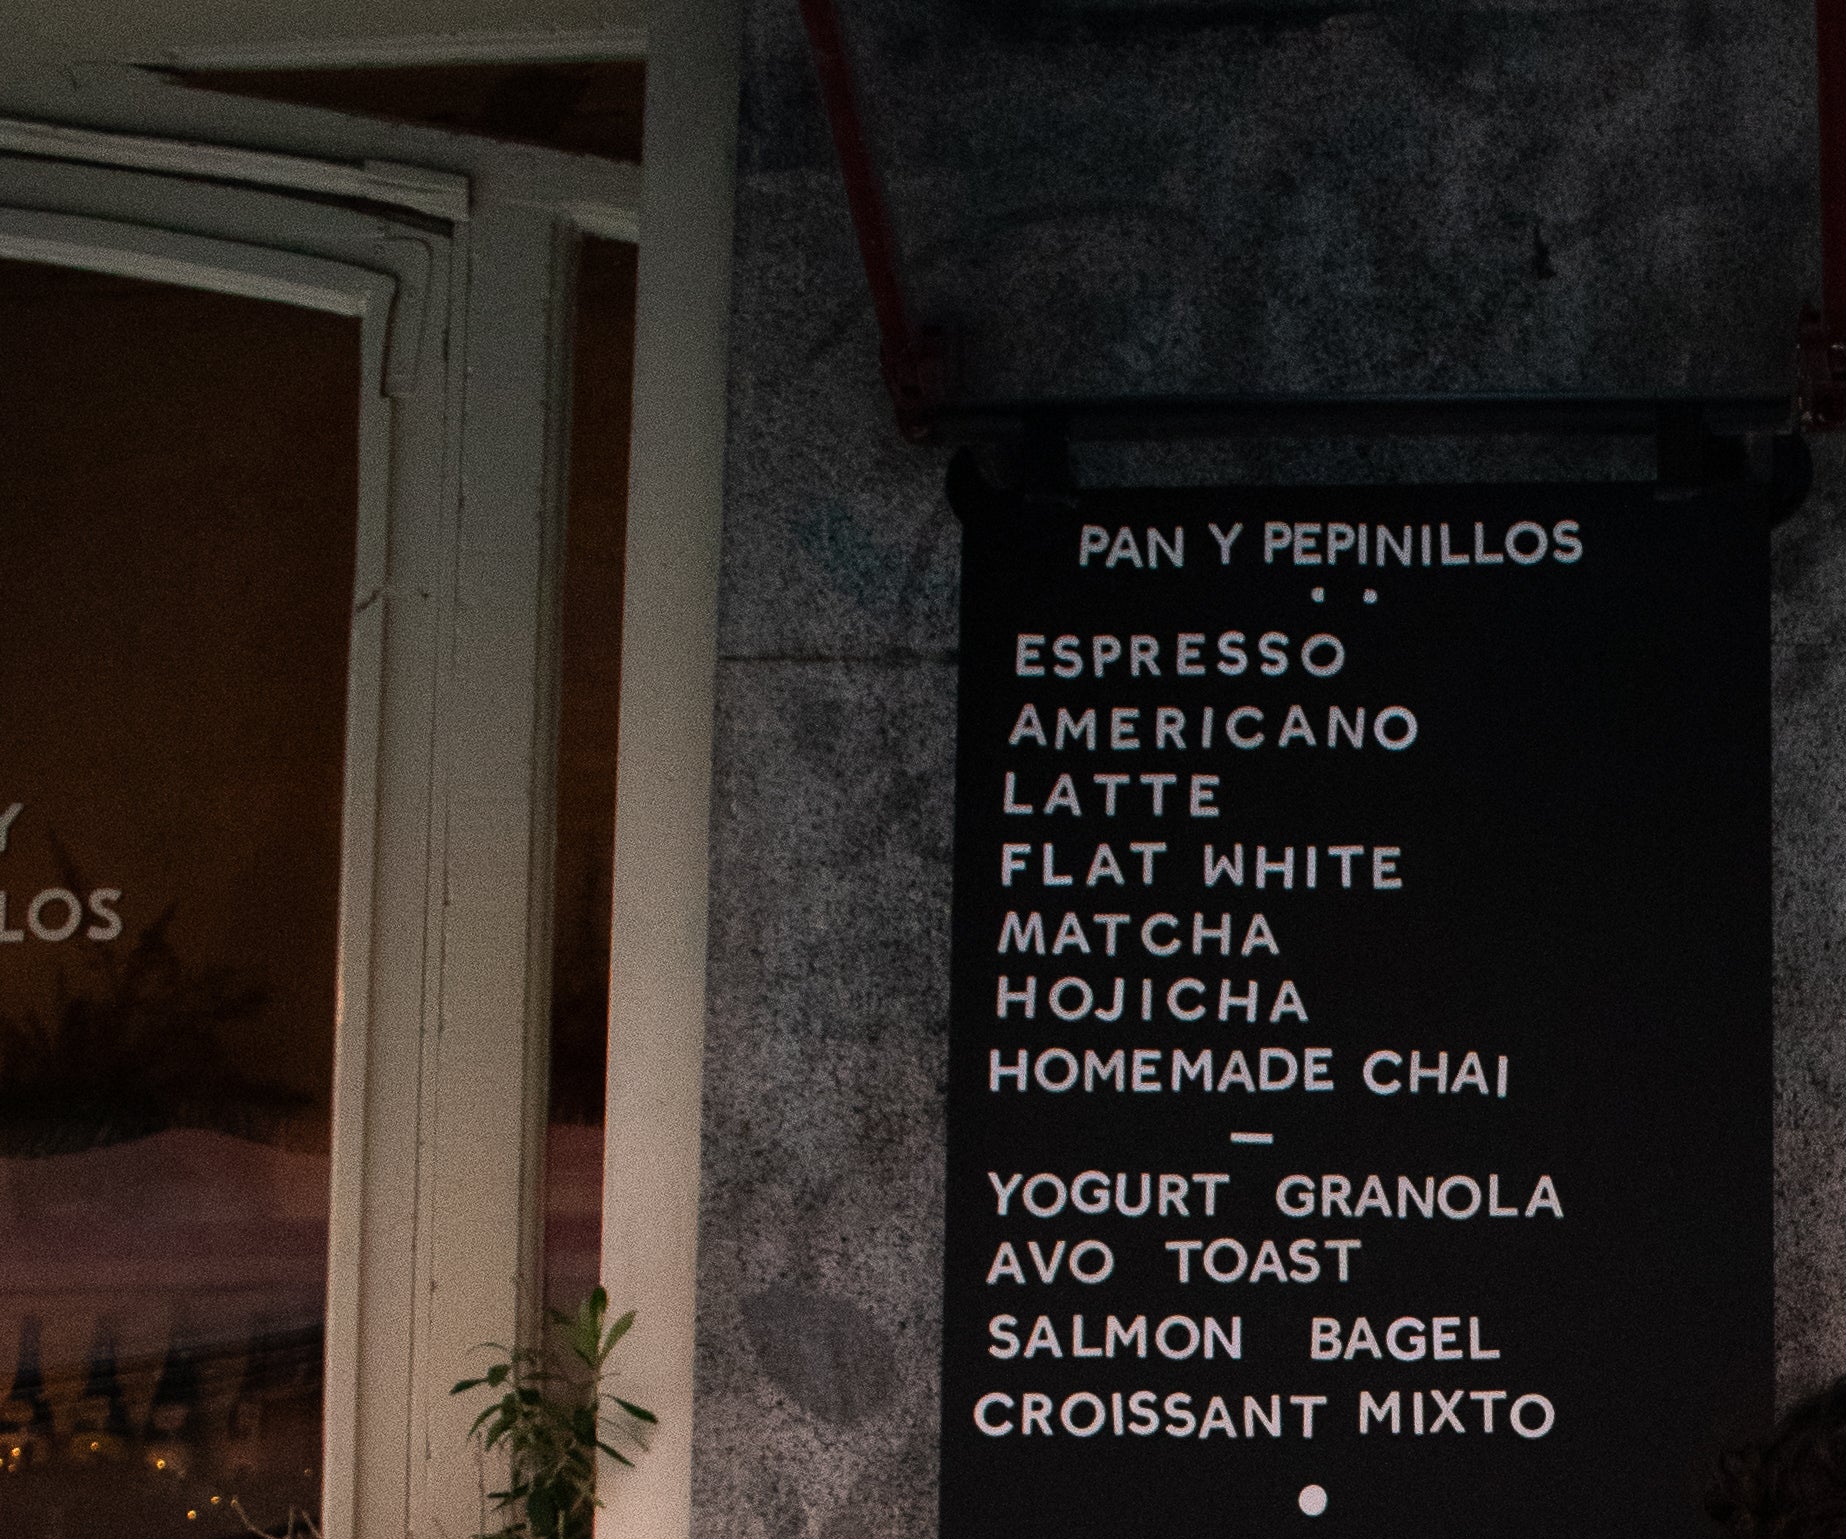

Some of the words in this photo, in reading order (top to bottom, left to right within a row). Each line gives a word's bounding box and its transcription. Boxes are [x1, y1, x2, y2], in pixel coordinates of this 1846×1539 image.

[1079, 526, 1184, 567] PAN
[1209, 523, 1242, 564] Y
[1264, 520, 1583, 566] PEPINILLOS
[1016, 631, 1345, 678] ESPRESSO
[1009, 704, 1419, 750] AMERICANO
[1003, 771, 1220, 817] LATTE
[1001, 842, 1168, 887] FLAT
[1203, 843, 1403, 890] WHITE
[997, 911, 1280, 957] MATCHA
[996, 975, 1309, 1023] HOJICHA
[988, 1047, 1335, 1093] HOMEMADE
[1361, 1049, 1509, 1098] CHAI
[987, 1169, 1231, 1219] YOGURT
[1274, 1173, 1565, 1221] GRANOLA
[985, 1239, 1115, 1286] AVO
[1164, 1237, 1363, 1285] TOAST
[988, 1313, 1243, 1361] SALMON
[1309, 1315, 1502, 1363] BAGEL
[972, 1389, 1329, 1440] CROISSANT
[1358, 1388, 1557, 1440] MIXTO
